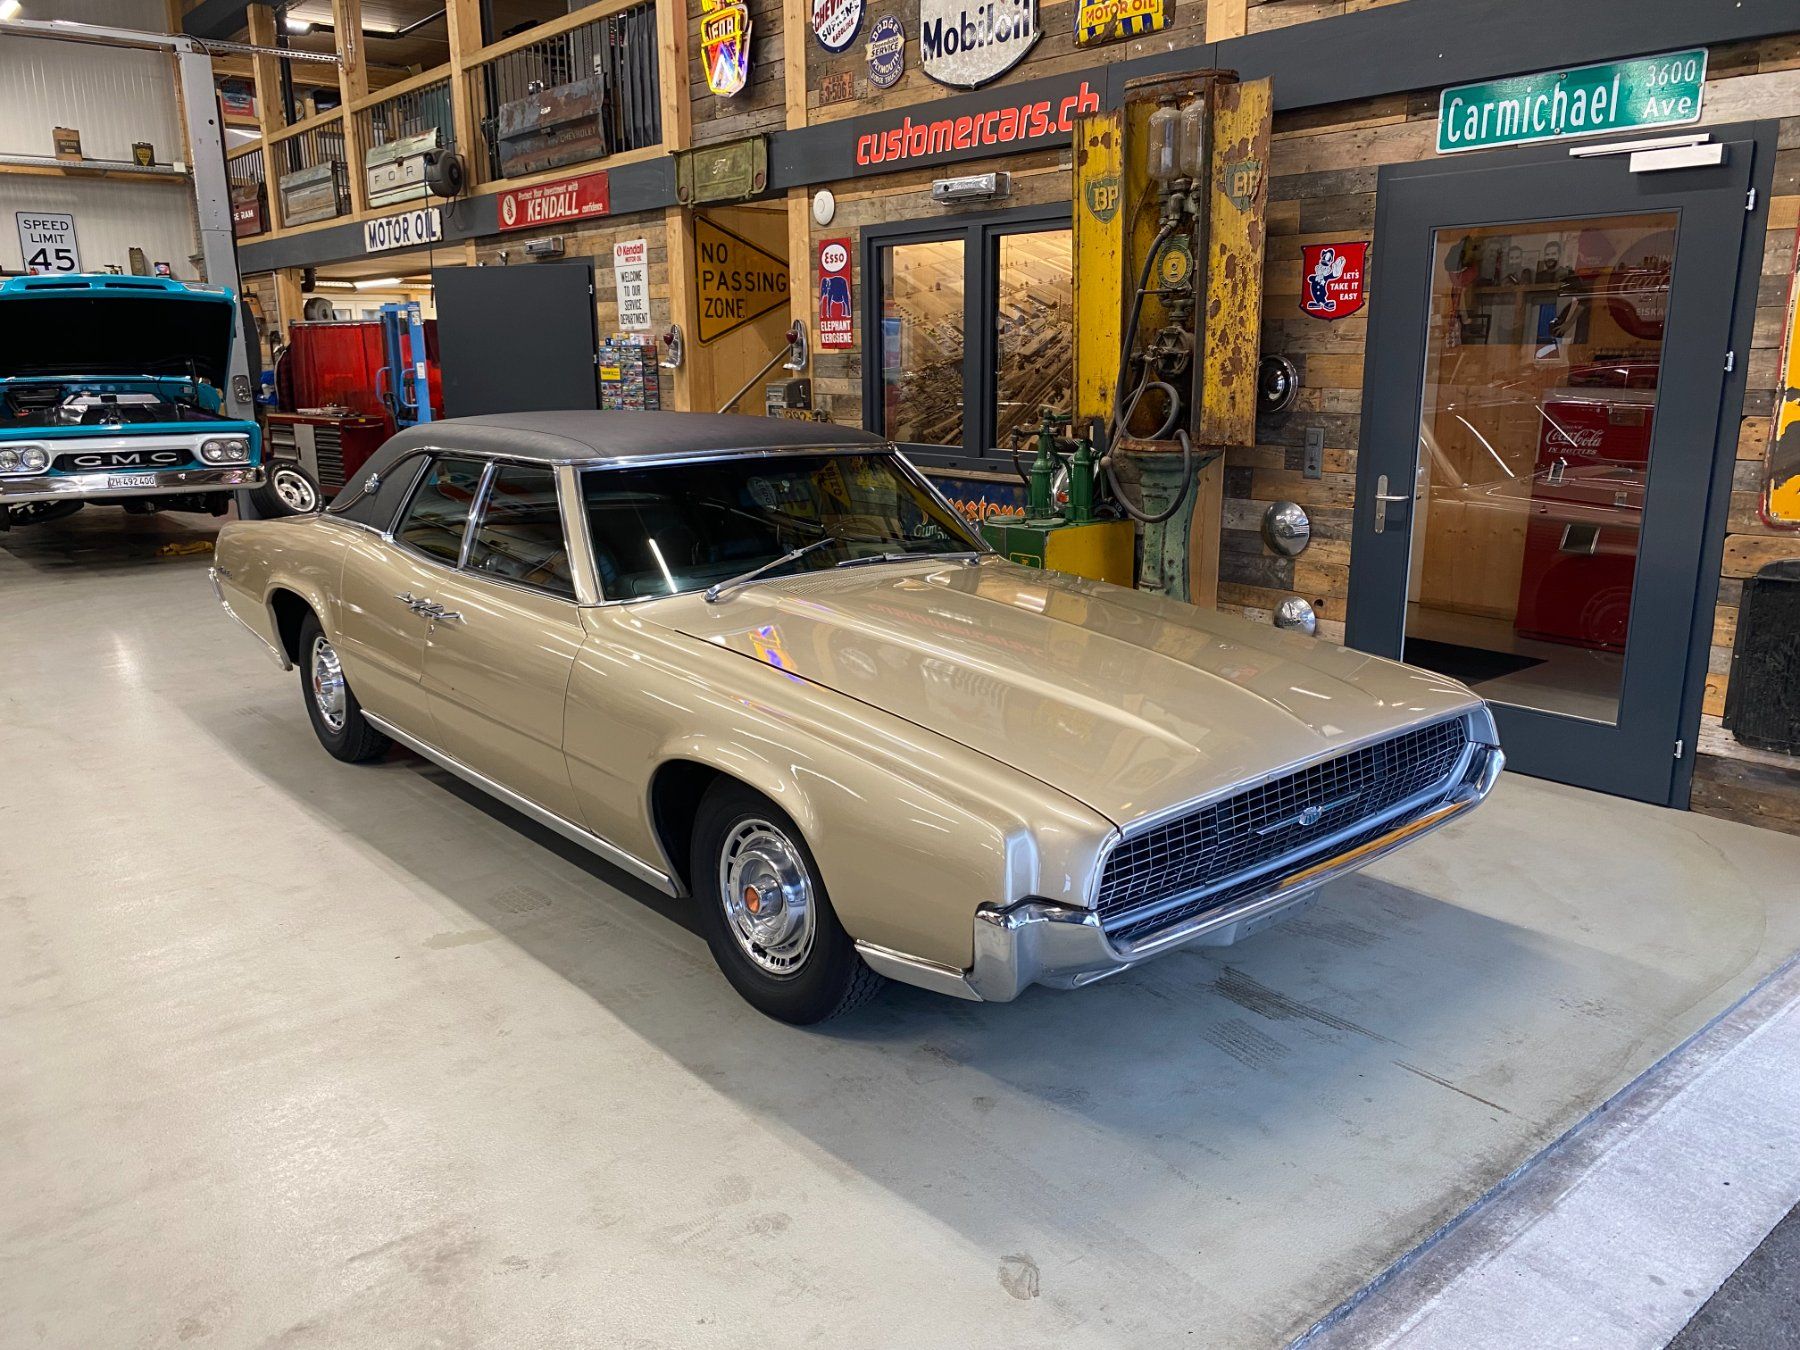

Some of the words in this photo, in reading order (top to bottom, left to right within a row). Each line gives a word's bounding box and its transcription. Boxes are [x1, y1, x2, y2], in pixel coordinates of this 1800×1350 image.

[1086, 1, 1128, 23] MOTOR
[872, 17, 899, 41] DODGE
[923, 0, 1030, 61] Mobiloil
[871, 42, 899, 57] SERVICE
[872, 53, 900, 74] PLYMOUTH
[1646, 59, 1697, 87] 3600
[1447, 72, 1621, 143] Carmichael
[1642, 95, 1692, 119] Ave
[856, 81, 1101, 166] customercars.ch
[561, 126, 596, 142] CHEVROLET
[374, 165, 413, 184] FOR
[1231, 170, 1261, 198] BP
[527, 192, 579, 222] KENDALL
[1094, 186, 1119, 211] BP
[23, 219, 69, 231] SPEED
[368, 216, 411, 249] MOTOR
[415, 209, 437, 240] OIL
[30, 233, 65, 244] LIMIT
[28, 247, 75, 271] 45
[622, 244, 644, 255] Kendall
[701, 242, 728, 264] NO
[621, 270, 642, 283] WELCOME
[702, 270, 787, 292] PASSING
[1343, 269, 1360, 280] LET'S
[624, 286, 630, 296] TO
[632, 285, 641, 296] OUR
[1330, 282, 1348, 291] TAKE
[1351, 282, 1359, 290] IT
[624, 299, 642, 311] SERVICE
[1340, 292, 1358, 301] EASY
[704, 297, 745, 318] ZONE
[1636, 307, 1664, 316] EISKA
[620, 312, 648, 325] DEPARTMENT
[820, 320, 851, 331] ELEPHANT
[821, 332, 852, 344] KEROSENE
[1545, 427, 1605, 447] Coca-Cola
[74, 452, 178, 466] GMC
